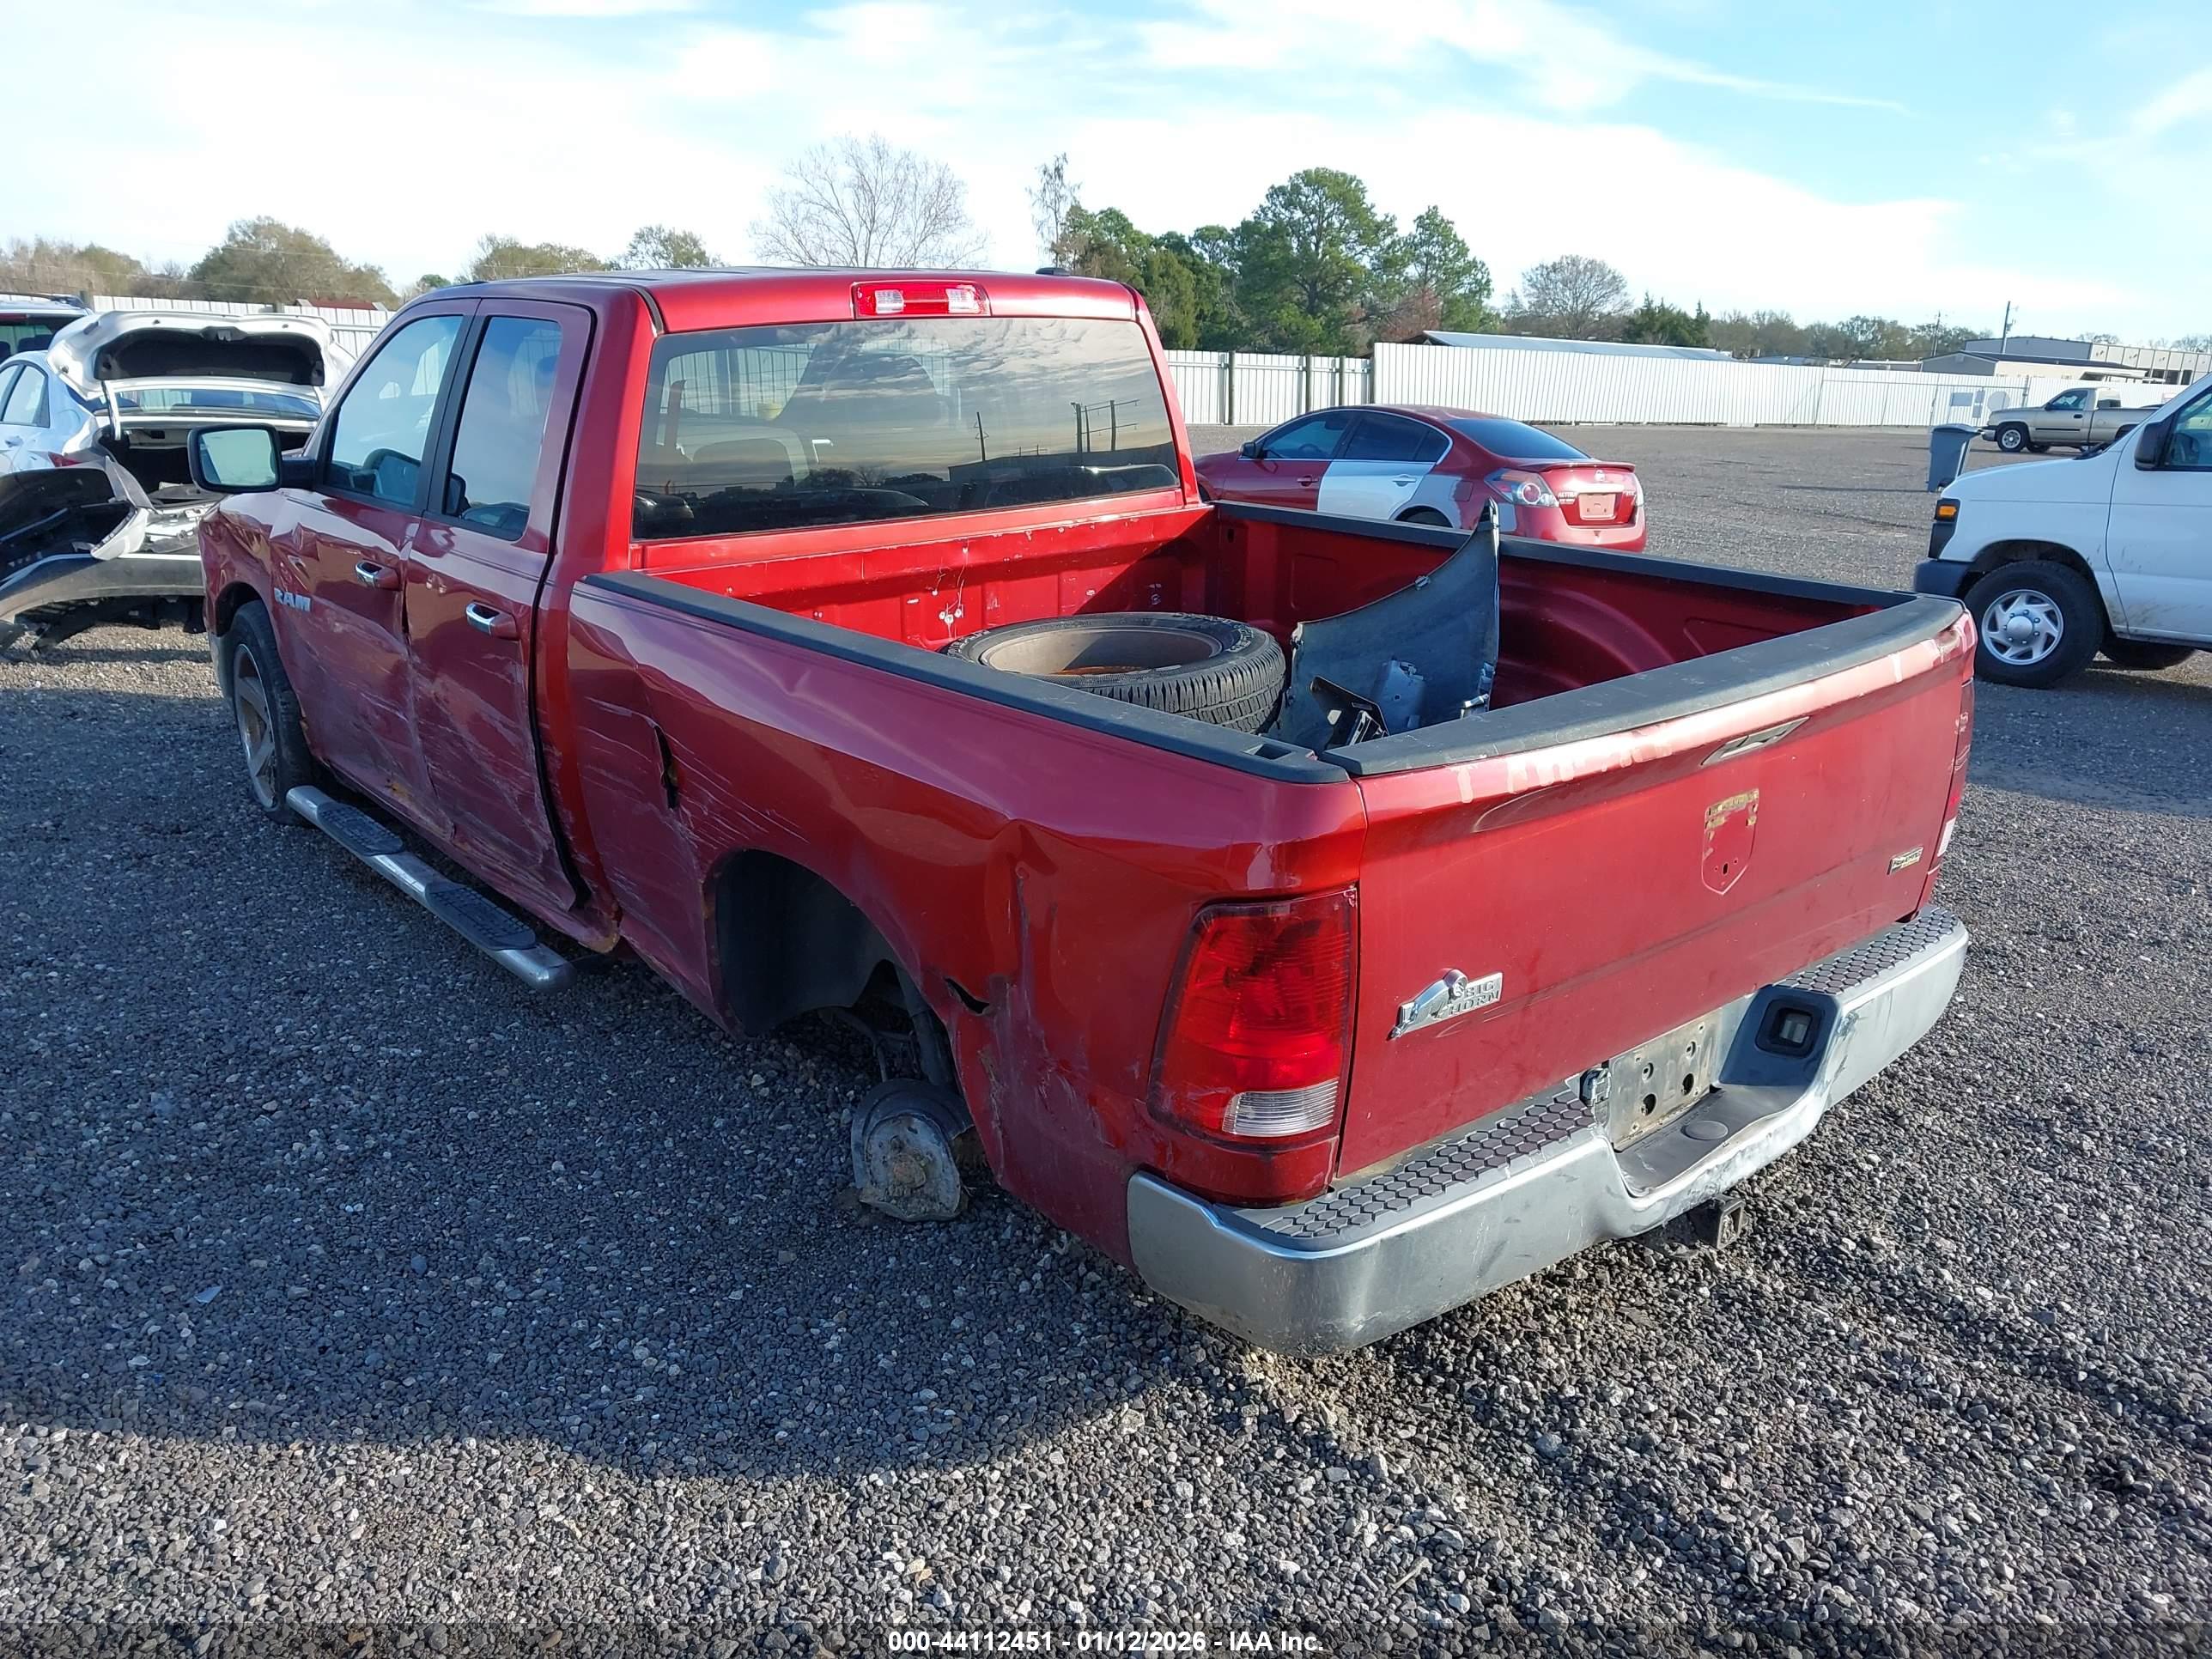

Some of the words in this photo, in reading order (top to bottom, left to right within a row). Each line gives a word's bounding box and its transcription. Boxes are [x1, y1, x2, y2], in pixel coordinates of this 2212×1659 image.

[274, 587, 311, 612] RAM
[1464, 980, 1495, 998] BIG
[1449, 990, 1499, 1014] HORN
